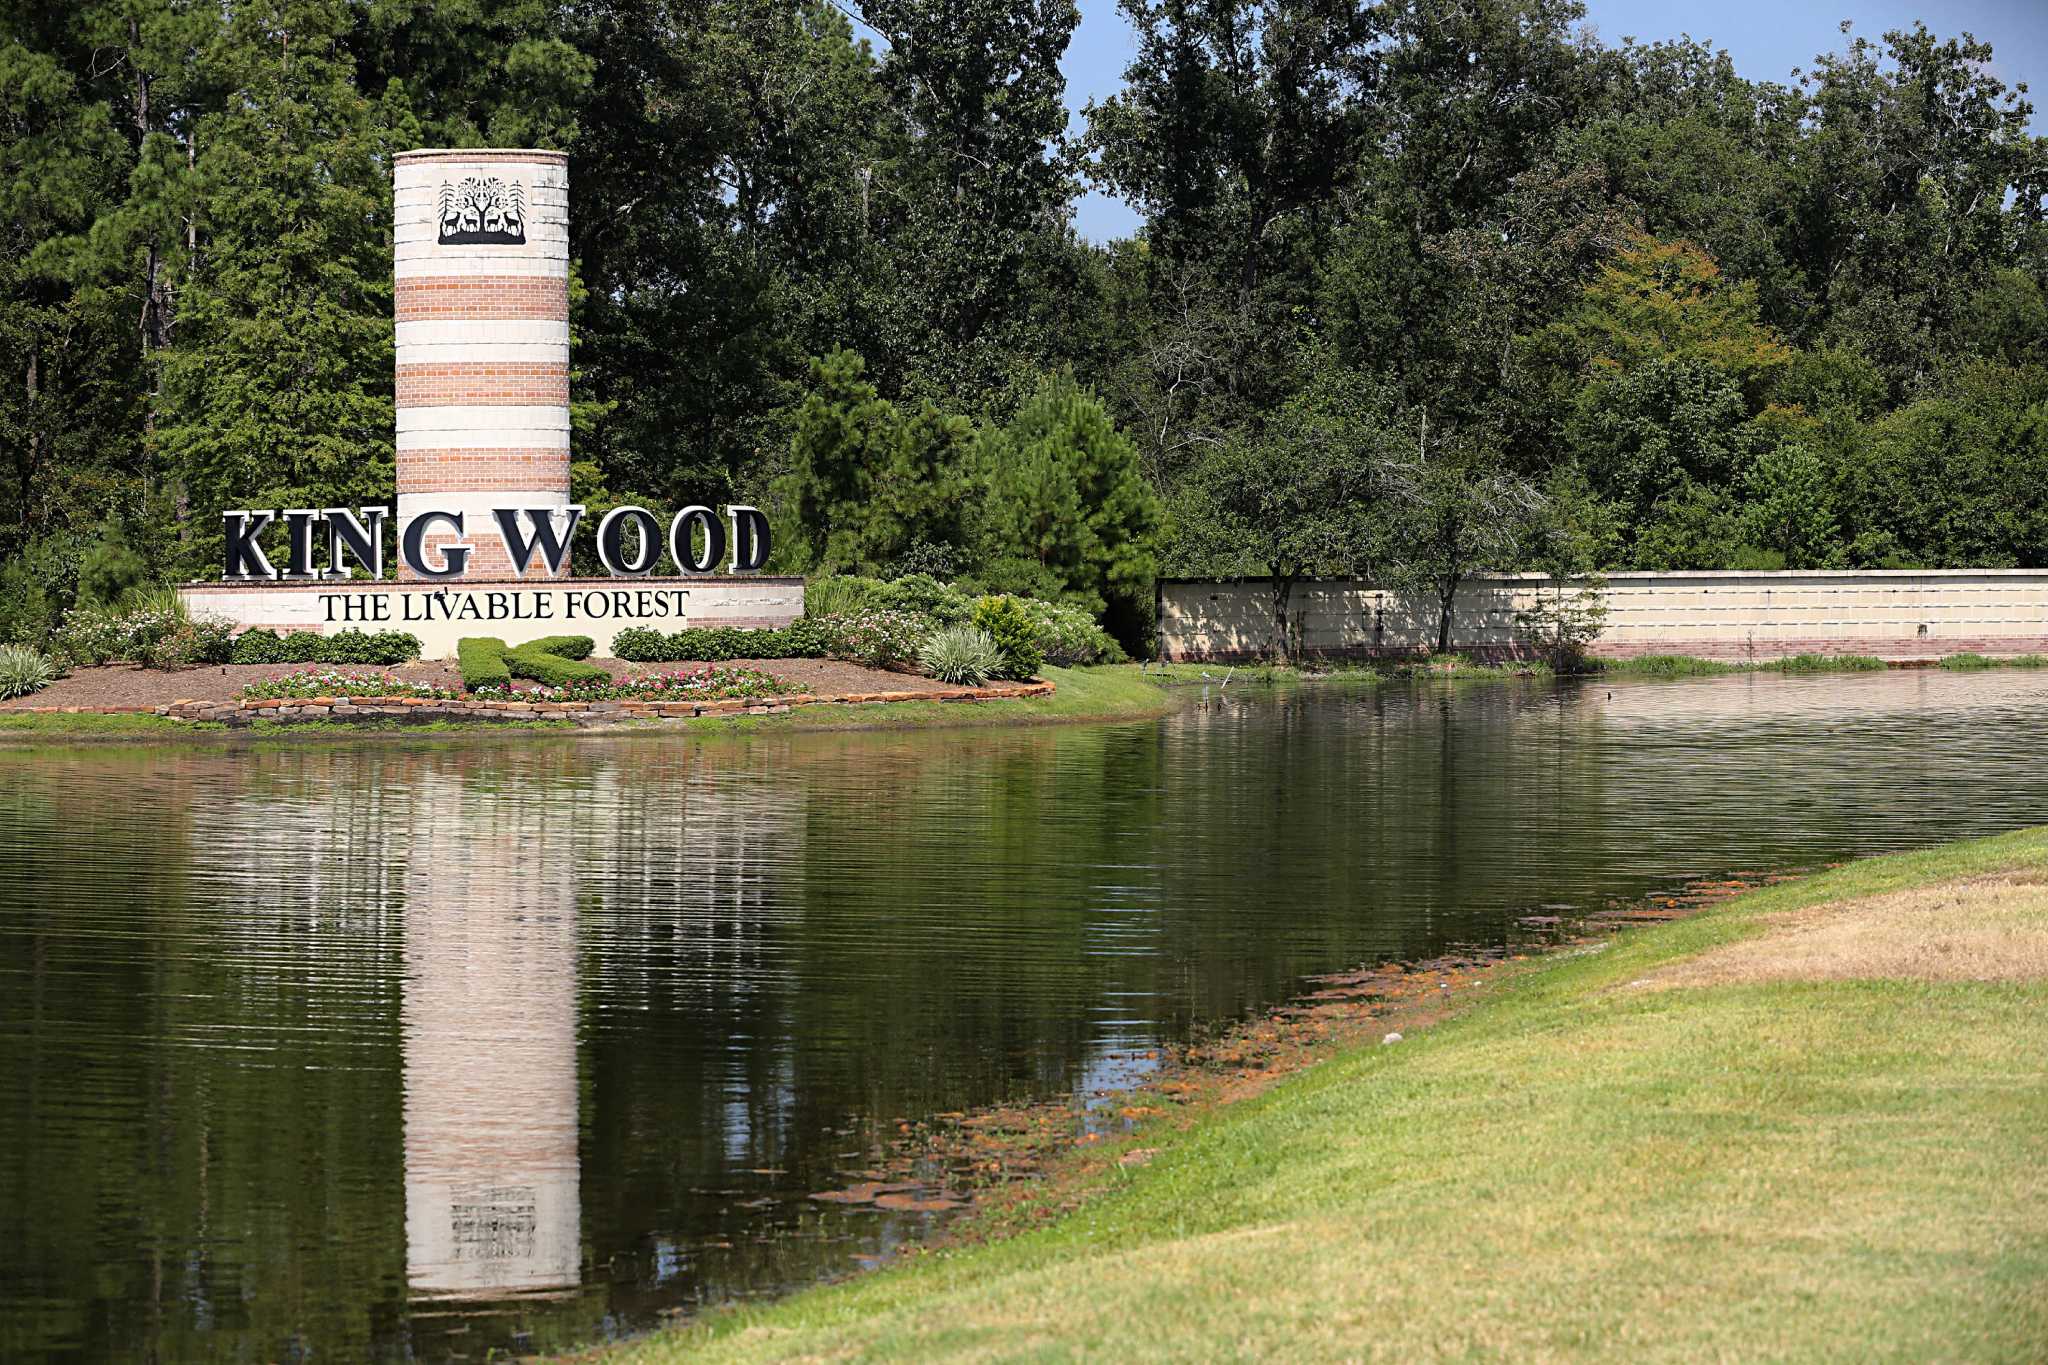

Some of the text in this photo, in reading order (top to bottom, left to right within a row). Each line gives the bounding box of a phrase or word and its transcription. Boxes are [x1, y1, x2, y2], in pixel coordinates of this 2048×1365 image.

[222, 505, 772, 580] KINGWOOD
[319, 590, 690, 622] THE LIVABLE FOREST
